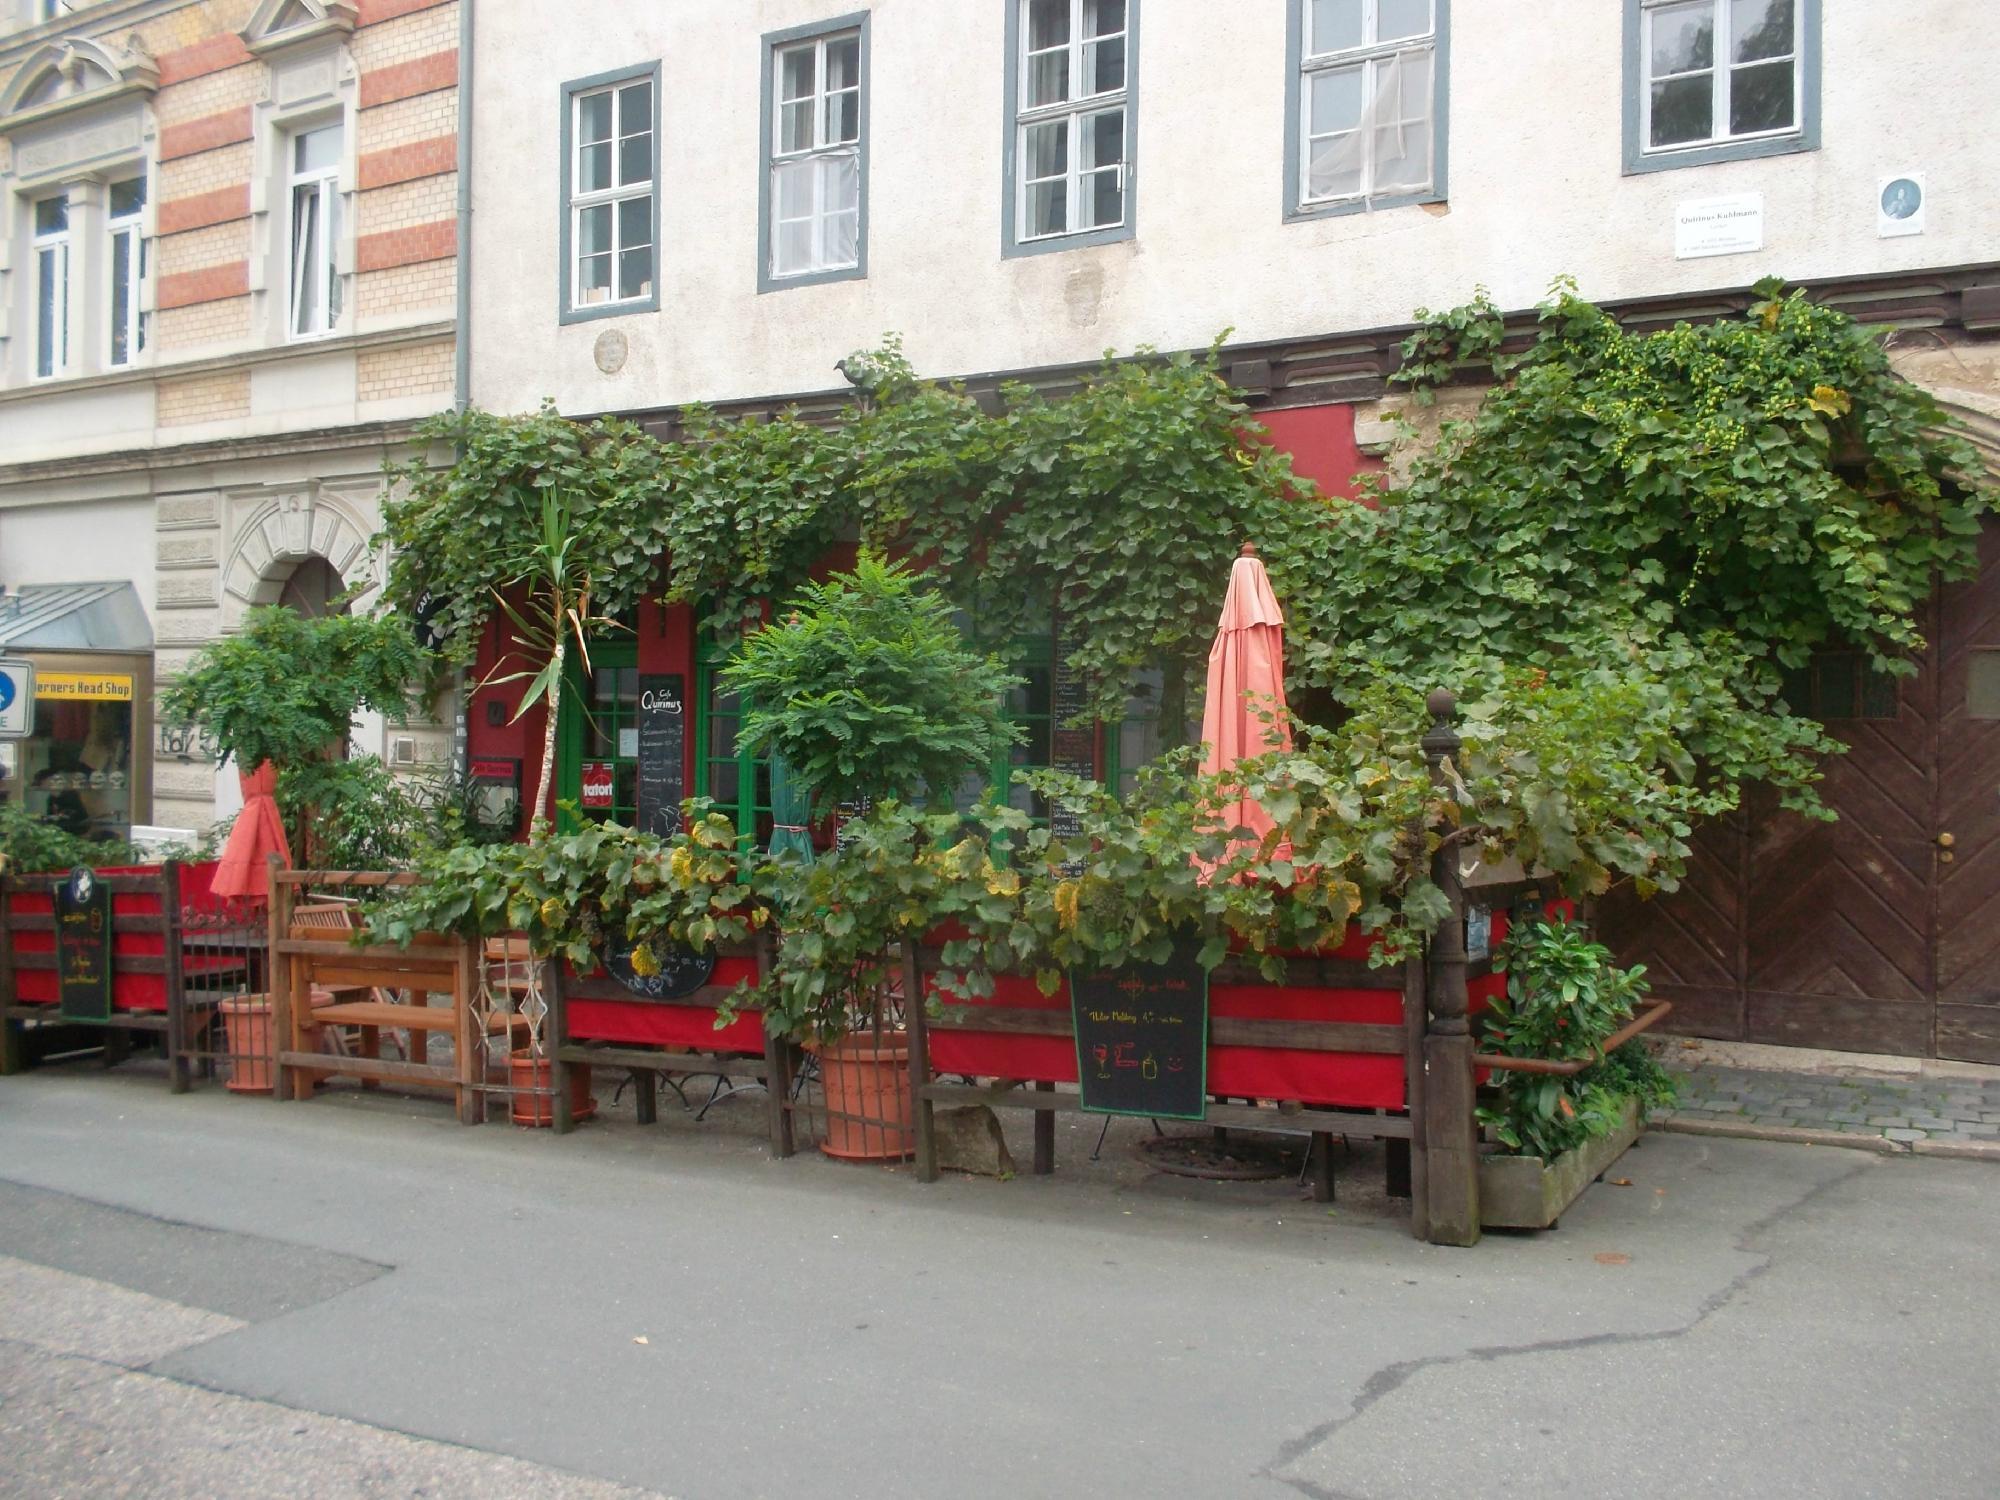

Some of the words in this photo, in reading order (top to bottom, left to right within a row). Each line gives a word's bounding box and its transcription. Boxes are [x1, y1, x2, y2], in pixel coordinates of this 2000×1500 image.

[35, 683, 75, 693] erners
[77, 682, 103, 694] Head
[105, 682, 129, 697] Shop
[641, 690, 683, 714] Quirinus
